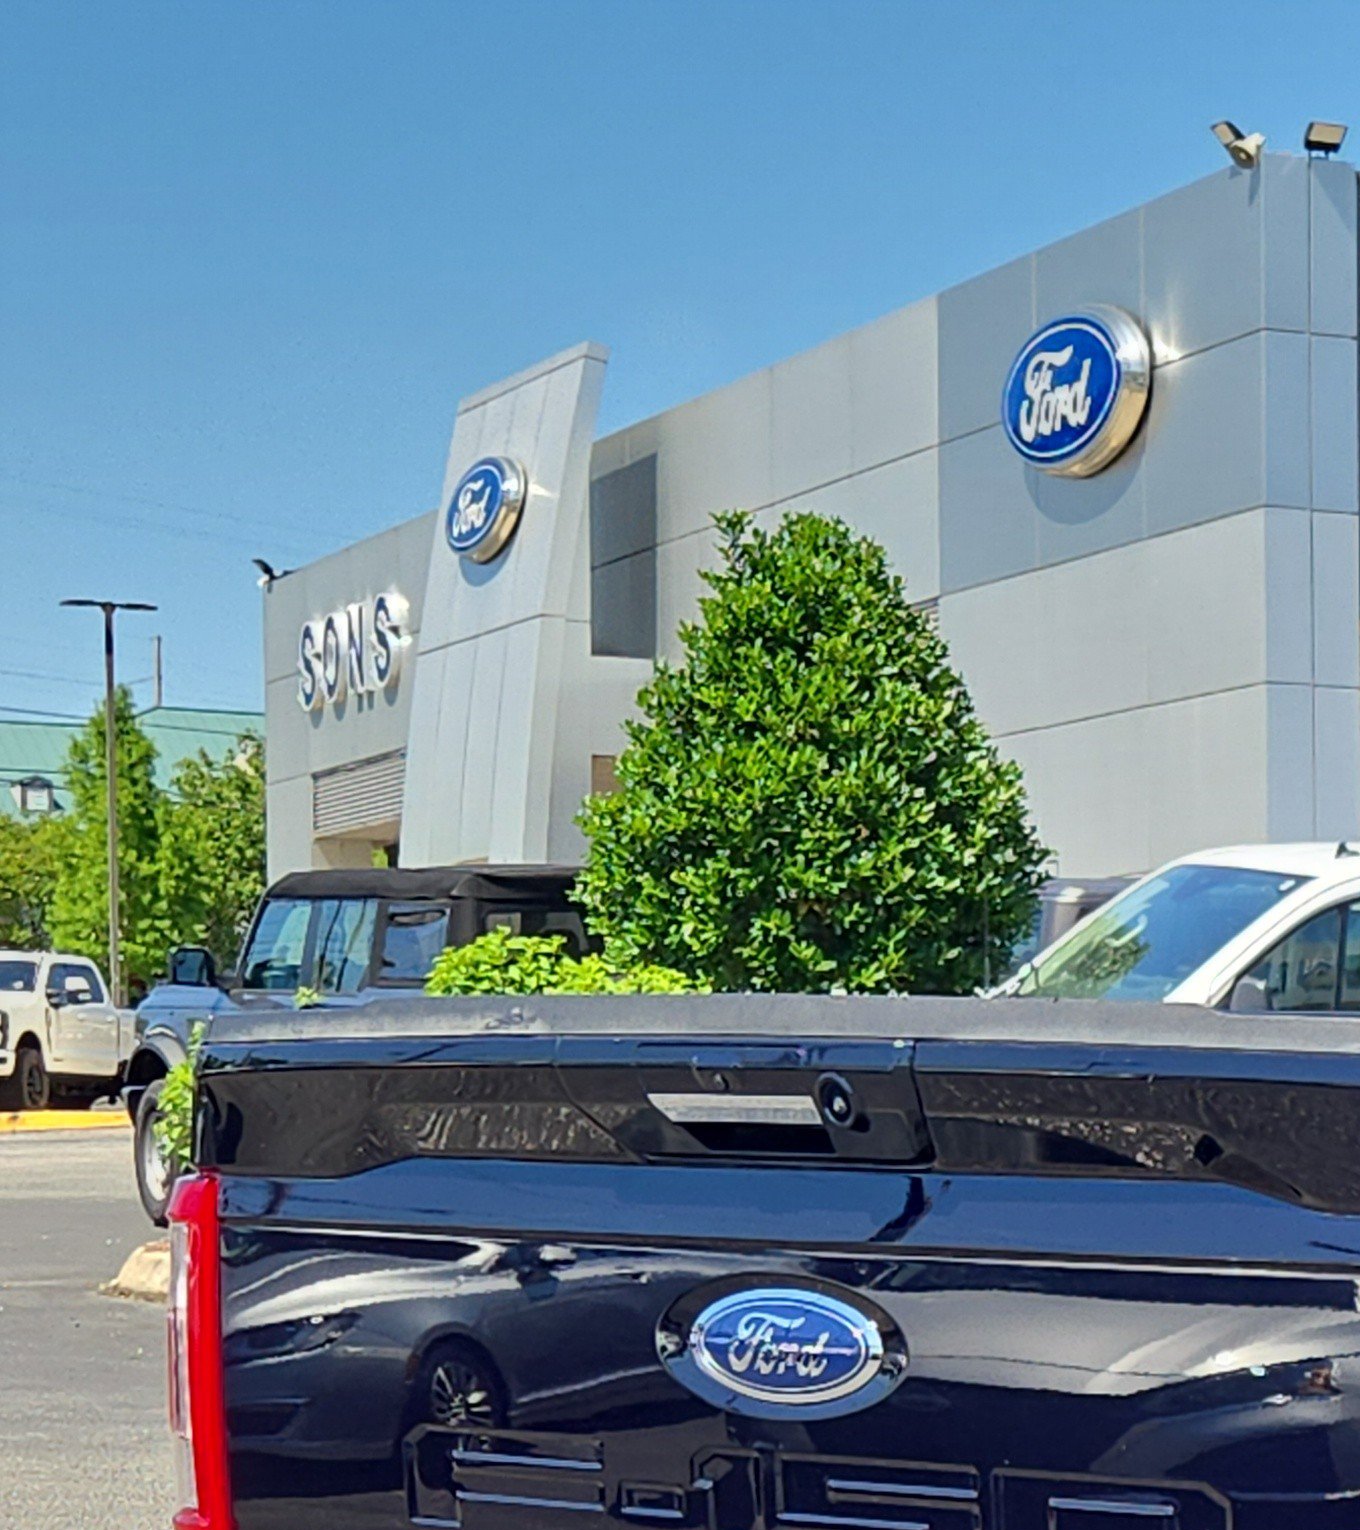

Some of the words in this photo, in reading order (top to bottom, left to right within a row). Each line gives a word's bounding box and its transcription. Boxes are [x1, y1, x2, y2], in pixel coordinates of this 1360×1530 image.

[1019, 344, 1092, 442] Ford
[452, 477, 492, 538] Ford
[300, 592, 391, 708] SONS
[727, 1311, 831, 1378] Ford
